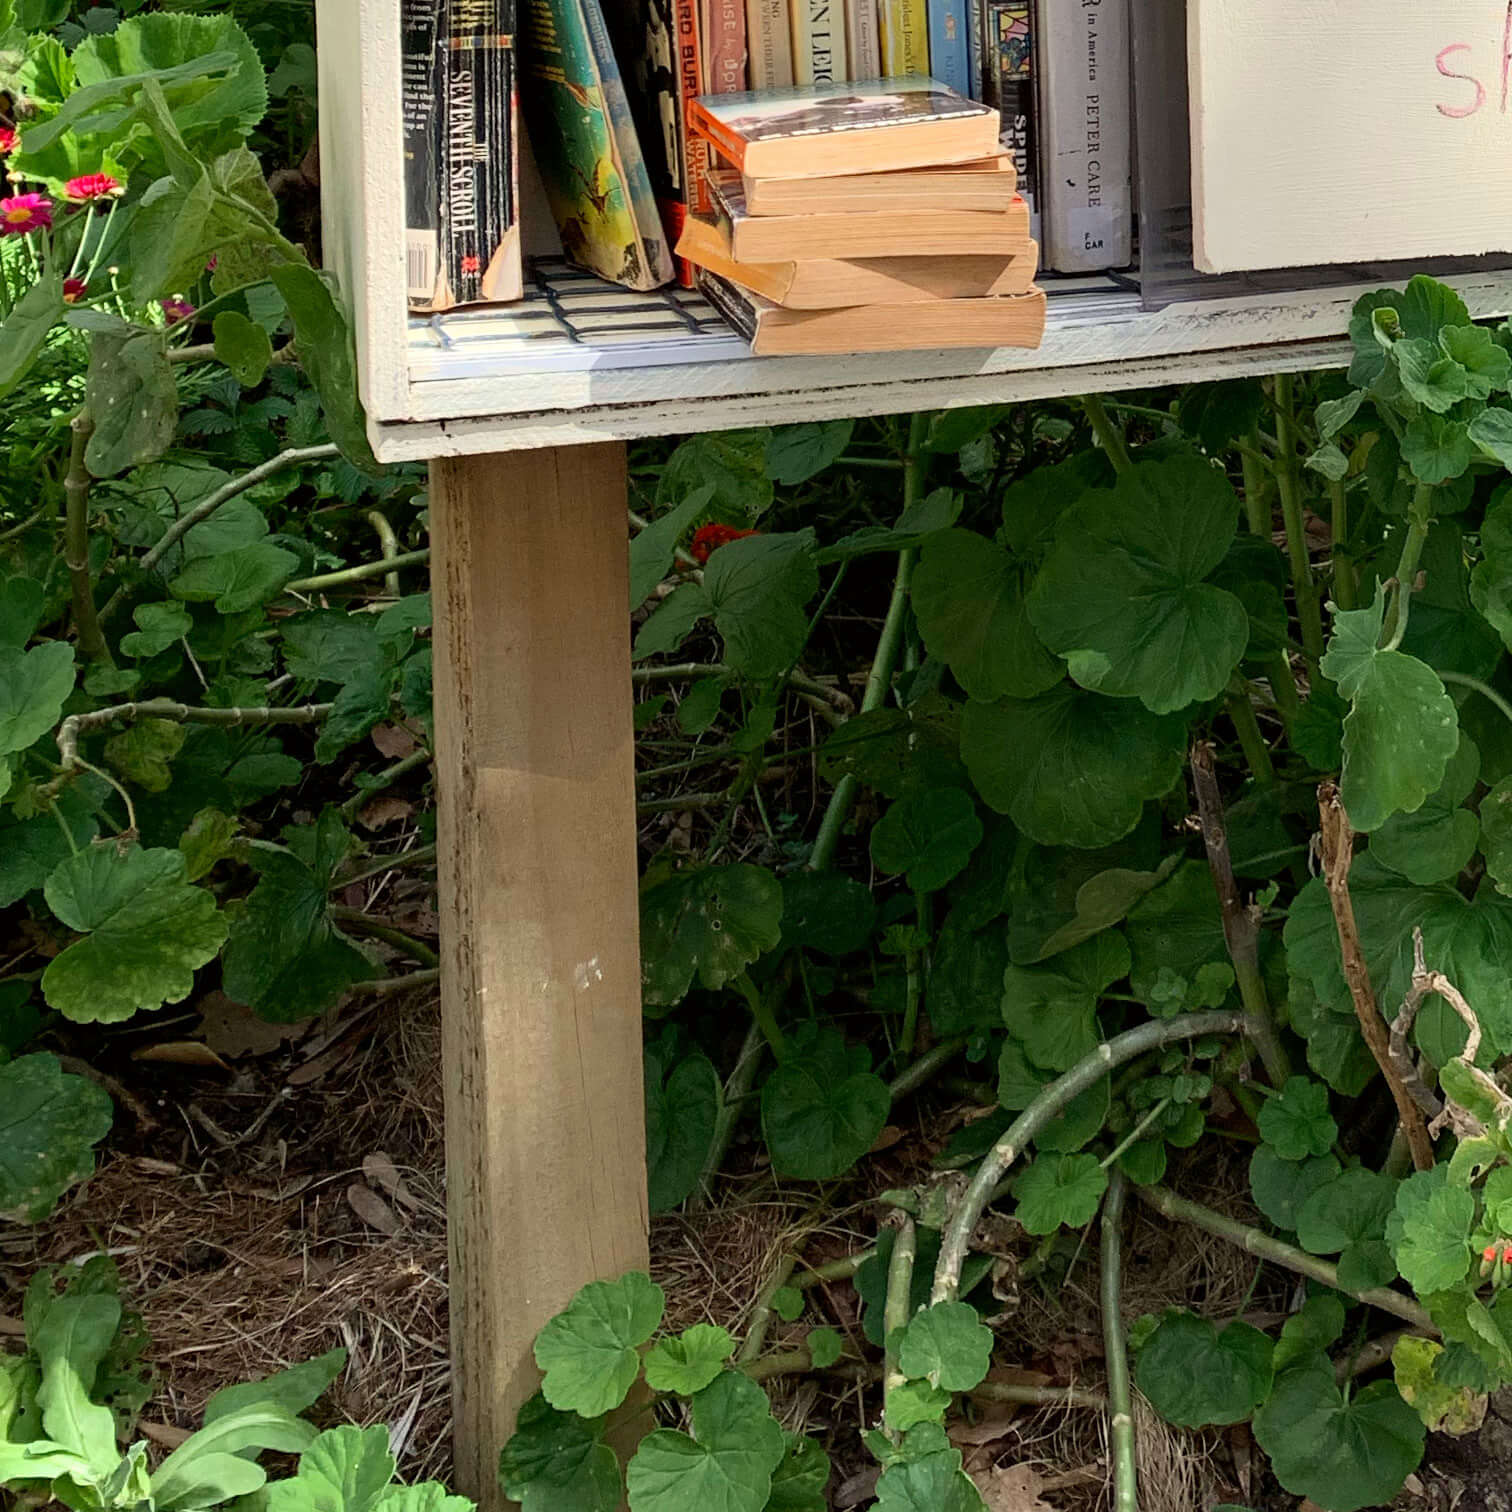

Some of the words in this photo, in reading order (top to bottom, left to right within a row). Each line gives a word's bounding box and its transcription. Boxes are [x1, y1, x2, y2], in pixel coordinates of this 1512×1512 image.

[1087, 13, 1098, 25] in
[1087, 30, 1099, 82] America
[449, 70, 473, 161] SEVENTH
[1086, 94, 1101, 154] PETER
[472, 143, 489, 162] THE
[450, 165, 476, 238] SCROLL
[1085, 240, 1104, 250] CAR
